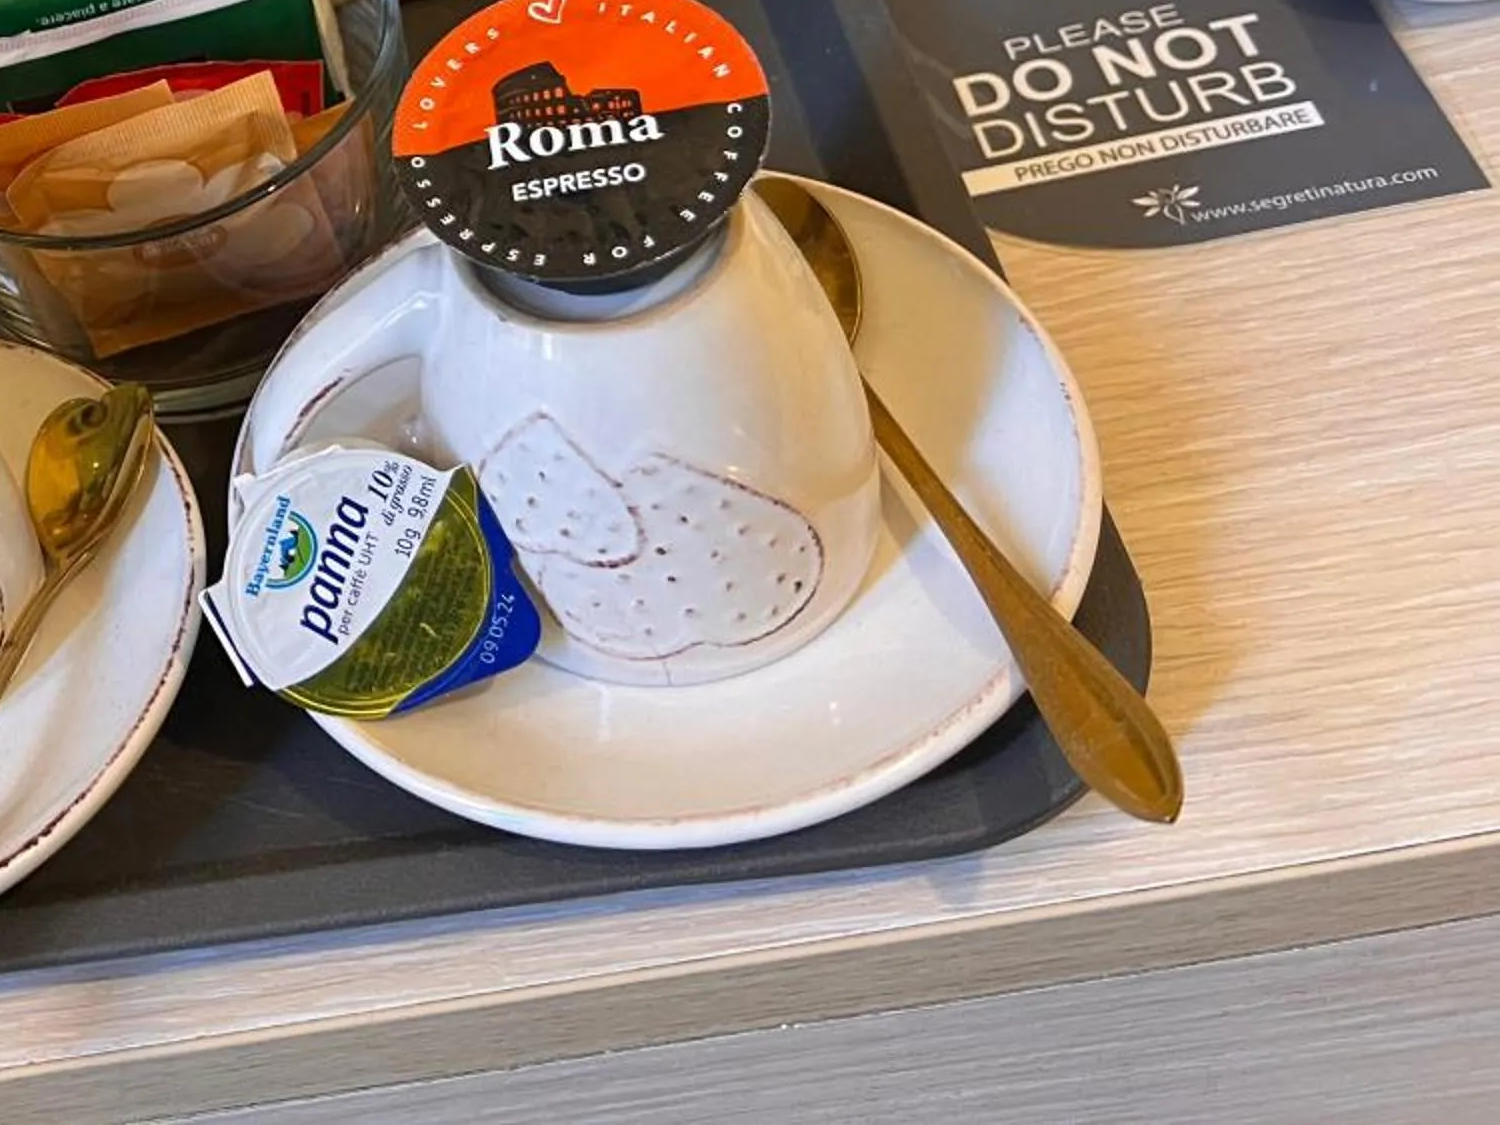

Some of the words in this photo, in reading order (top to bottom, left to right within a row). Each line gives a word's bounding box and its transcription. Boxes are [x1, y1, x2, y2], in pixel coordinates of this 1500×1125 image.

[598, 2, 731, 78] ITALIAN
[953, 58, 1073, 117] DO
[1092, 13, 1260, 86] NOT
[1003, 3, 1184, 61] PLEASE
[412, 27, 500, 131] LOVERS
[972, 61, 1297, 160] DISTURB
[483, 112, 666, 170] Roma
[679, 103, 744, 223] COFFEE
[1014, 151, 1094, 182] PREGO
[1100, 140, 1156, 165] NON
[1158, 107, 1312, 152] DISTURBARE
[410, 157, 546, 266] ESPRESSO
[511, 162, 646, 202] ESPRESSO
[1191, 165, 1439, 223] www.segretinatura.com
[583, 235, 656, 265] FOR
[368, 460, 399, 503] 10%
[245, 495, 292, 597] Bayernland
[300, 495, 369, 645] panna
[394, 528, 421, 559] 10g
[338, 610, 353, 636] per
[358, 531, 379, 566] UHT
